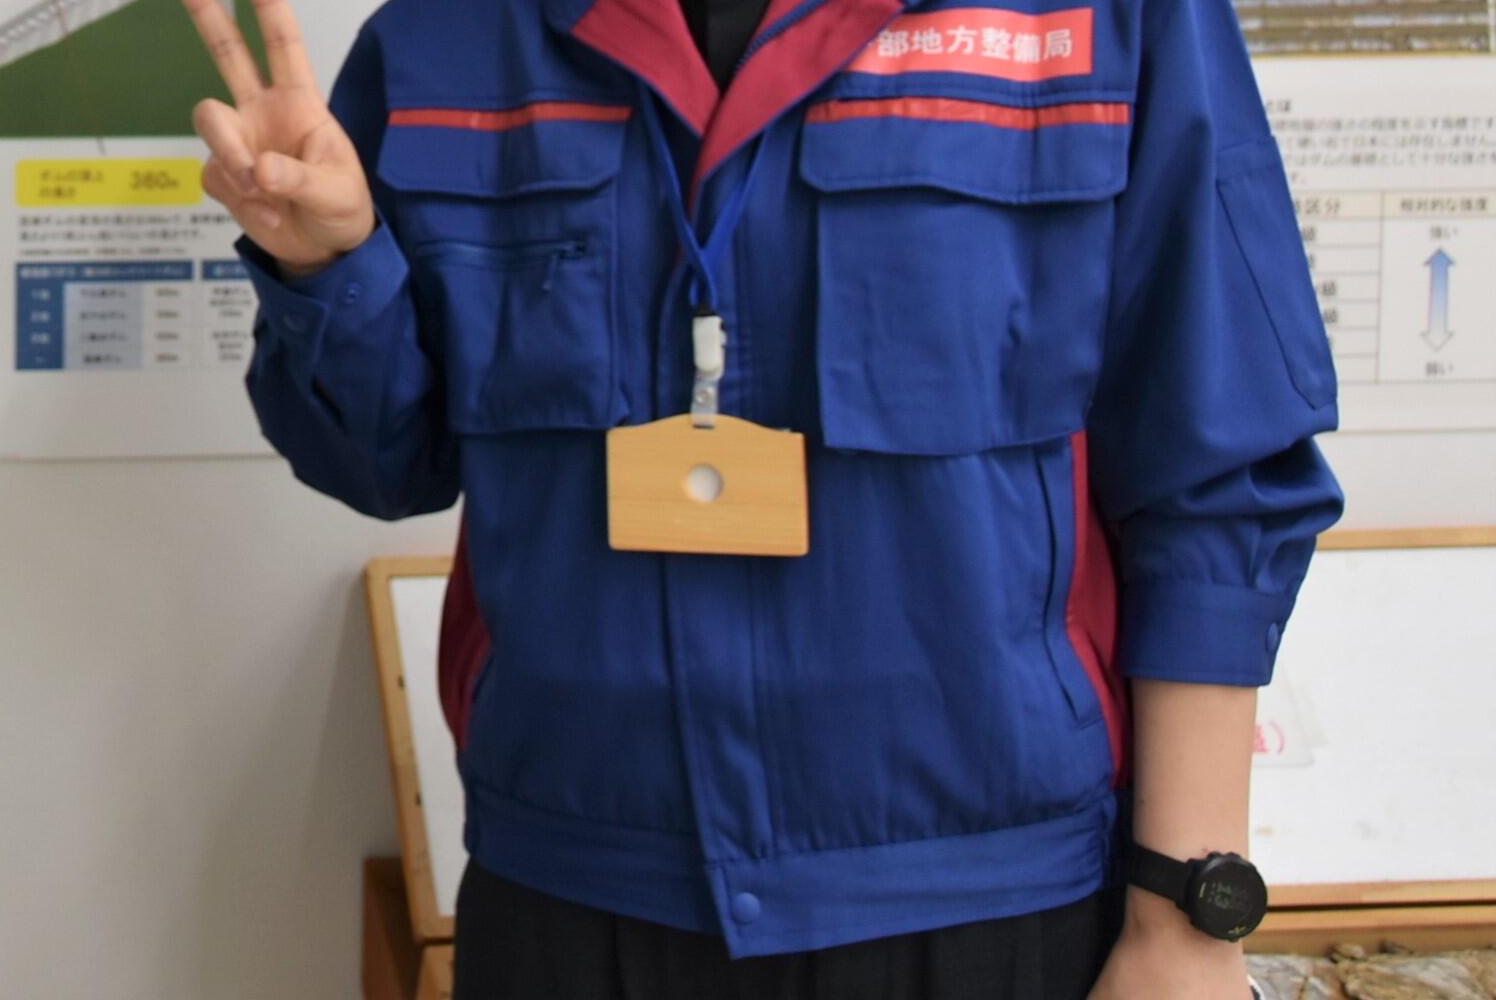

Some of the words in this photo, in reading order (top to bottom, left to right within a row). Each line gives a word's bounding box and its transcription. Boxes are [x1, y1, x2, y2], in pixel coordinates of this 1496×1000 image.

[868, 25, 1073, 64] 部地方整備局
[1298, 197, 1342, 216] 区分
